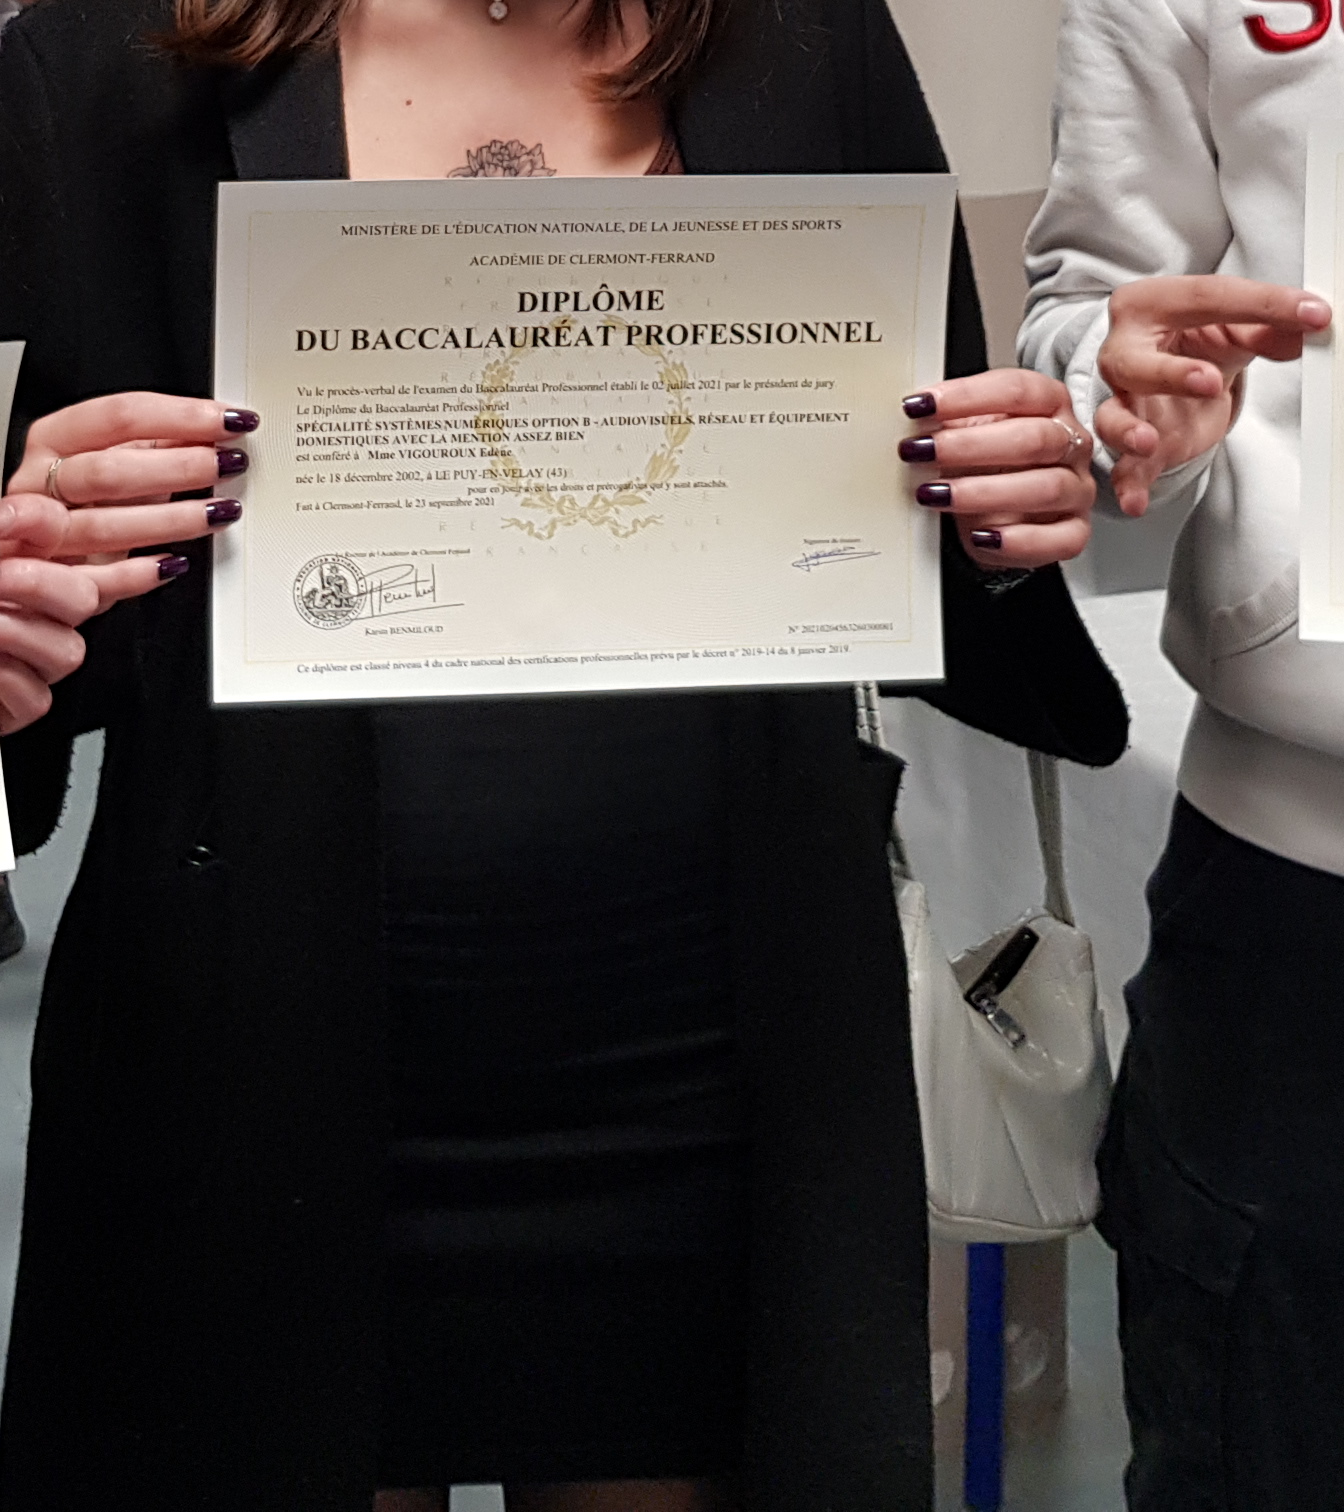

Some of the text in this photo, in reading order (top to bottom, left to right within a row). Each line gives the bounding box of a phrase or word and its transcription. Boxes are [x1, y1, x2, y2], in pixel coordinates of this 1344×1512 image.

[340, 218, 843, 237] MINISTÈRE DE L'ÉDUCATION NATIONALE, DE LA JEUNESSE ET DES SPORTS
[468, 251, 716, 267] ACADÉMIE DE CLERMONT-FERRAND
[516, 282, 665, 314] DIPLÔME
[295, 318, 883, 353] DU BACCALAURÉAT PROFESSIONNEL
[295, 430, 585, 449] DOMESTIQUES AVEC LA MENTION ASSEZ BIEN
